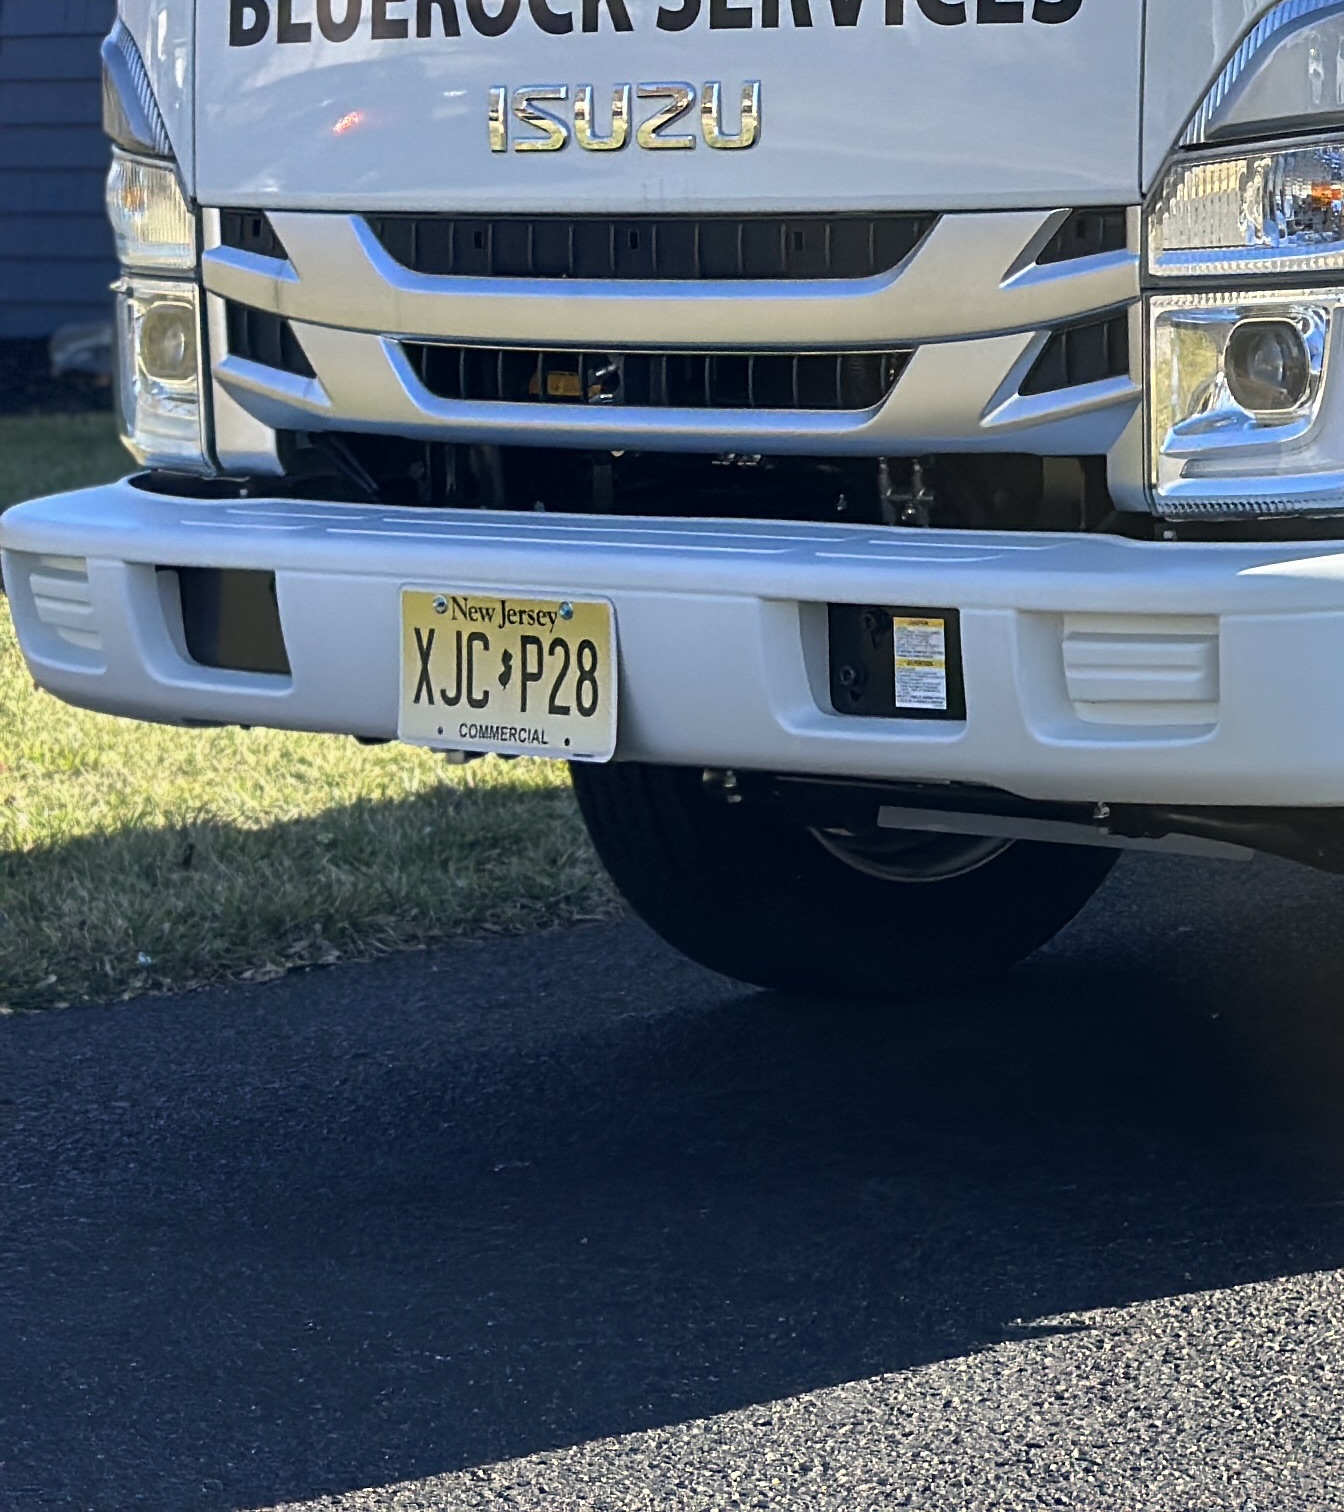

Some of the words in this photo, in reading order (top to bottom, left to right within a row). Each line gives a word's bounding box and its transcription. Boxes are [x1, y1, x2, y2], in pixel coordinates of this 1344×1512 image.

[487, 80, 763, 153] ISUZU
[451, 596, 496, 623] New
[498, 599, 558, 633] Jersey
[413, 627, 490, 709] XJC
[520, 634, 599, 718] P28
[458, 722, 549, 745] COMMERCIAL
